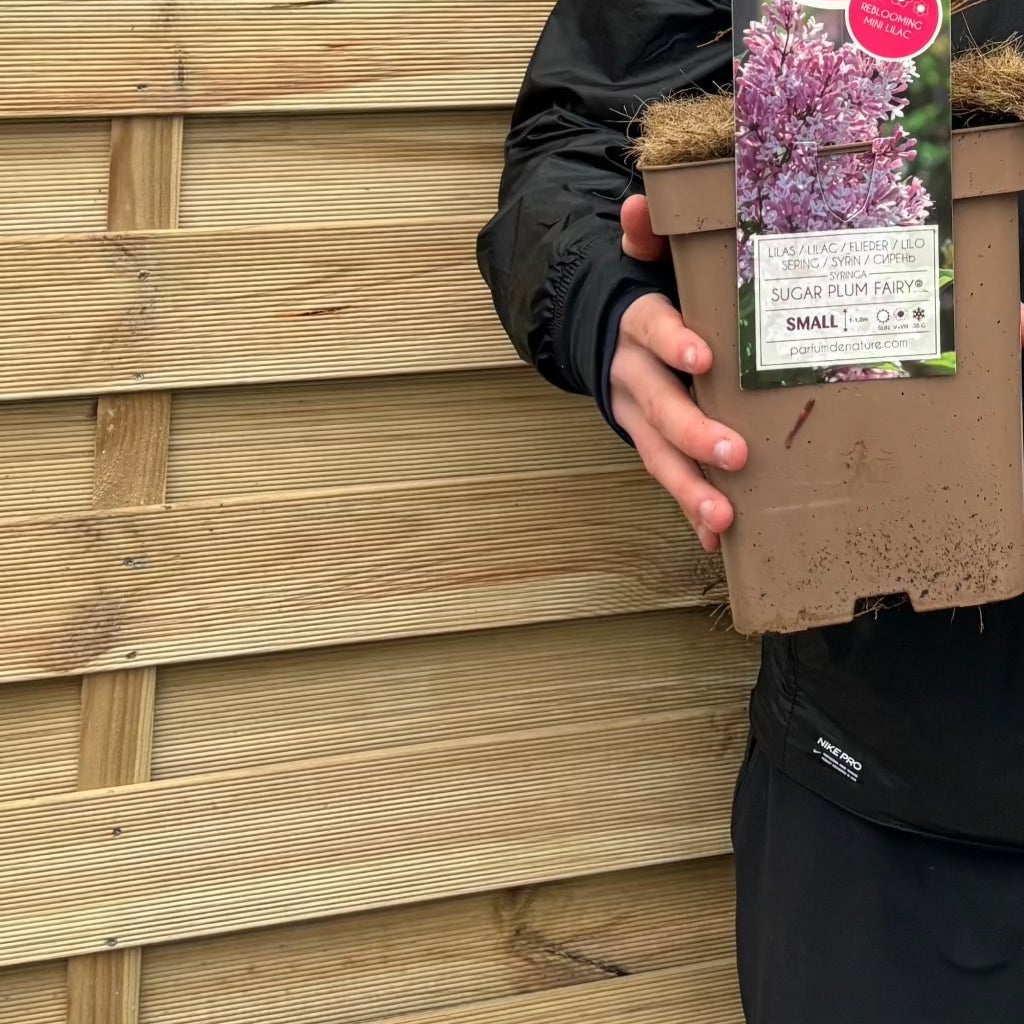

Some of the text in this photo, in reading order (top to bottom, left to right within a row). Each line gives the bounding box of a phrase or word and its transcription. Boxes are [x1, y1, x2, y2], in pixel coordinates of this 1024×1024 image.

[860, 1, 923, 30] REBLOOMING
[863, 16, 912, 39] MINI LILAC
[768, 246, 796, 257] LILAS
[807, 242, 837, 255] LILAC
[850, 239, 889, 252] FLIEDER
[901, 238, 925, 249] LILO
[782, 258, 820, 270] SERING
[831, 255, 861, 267] SYRIN
[829, 270, 867, 280] SYRINGA
[771, 285, 822, 302] SUGAR
[828, 282, 868, 298] PLUM
[786, 314, 839, 331] SMALL
[790, 339, 908, 357] parfumdenature.com
[817, 736, 842, 757] NIKE
[840, 752, 863, 771] PRO
